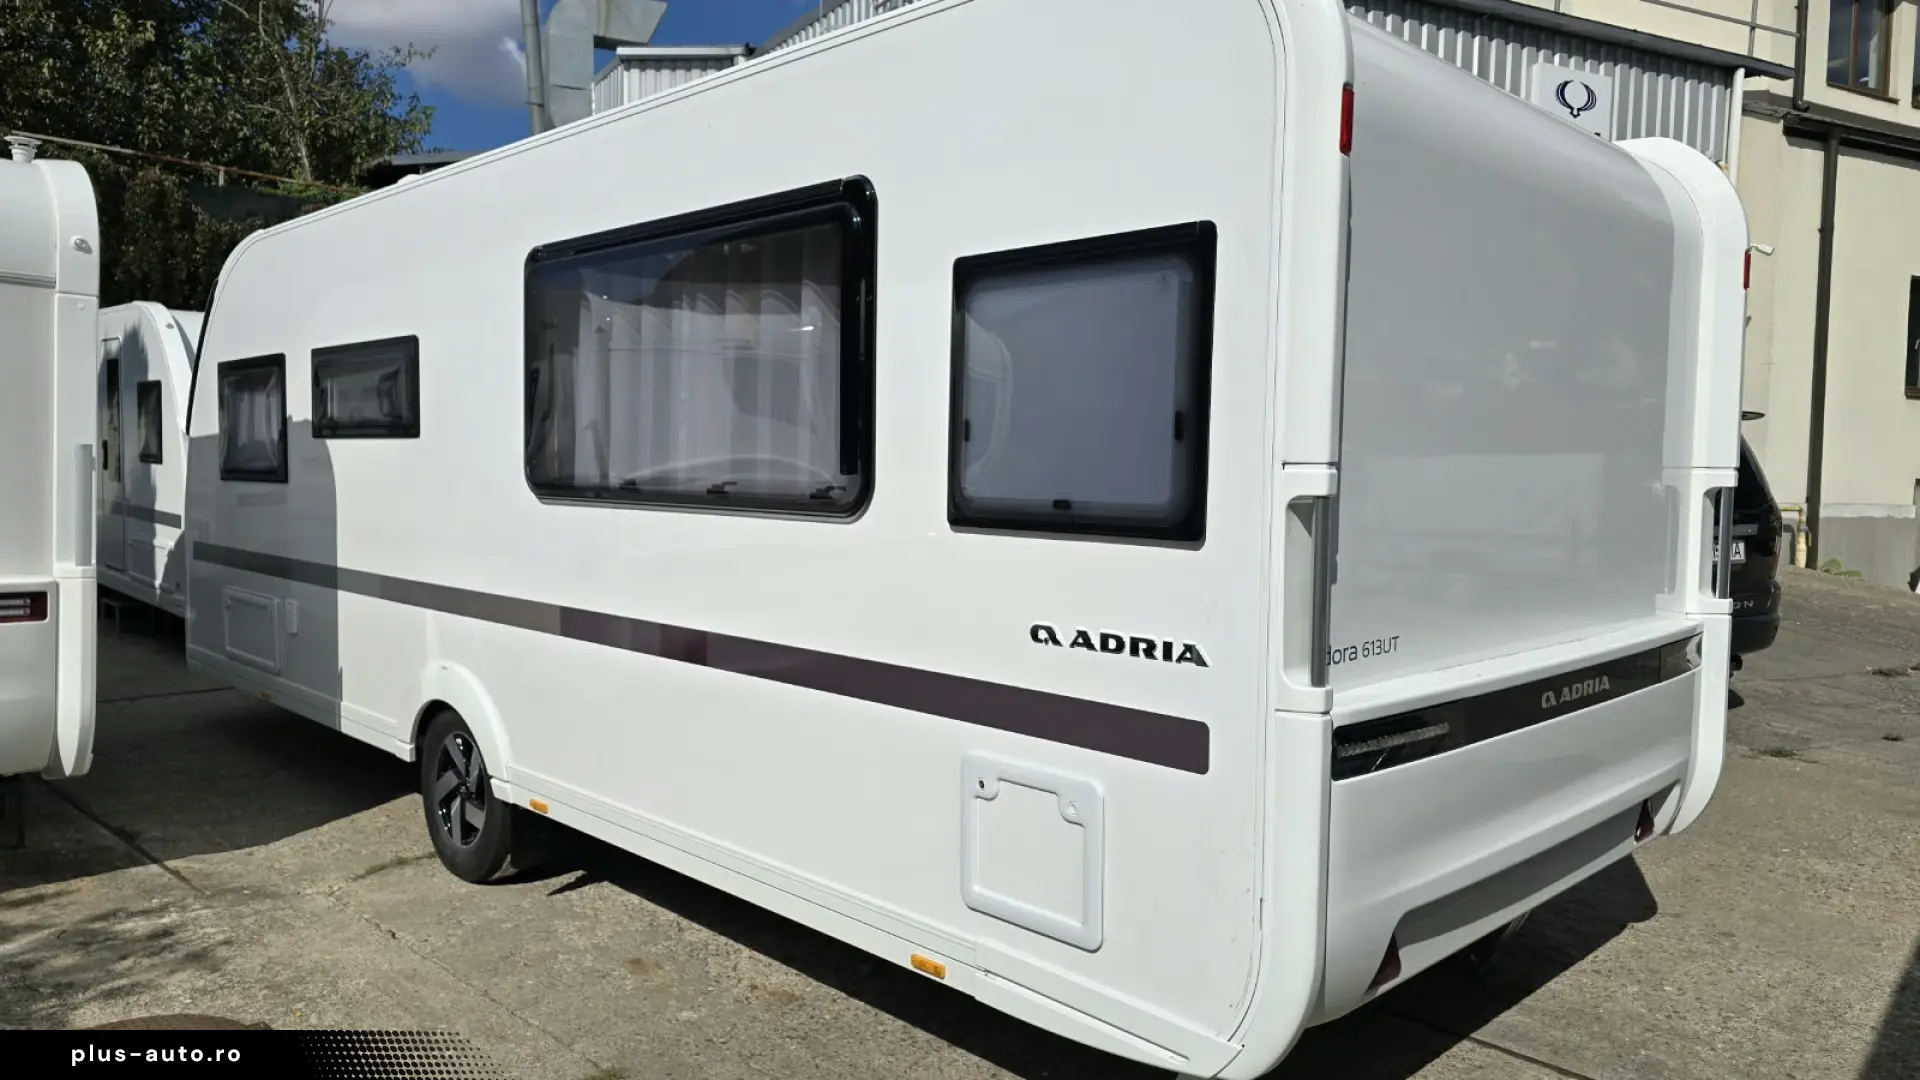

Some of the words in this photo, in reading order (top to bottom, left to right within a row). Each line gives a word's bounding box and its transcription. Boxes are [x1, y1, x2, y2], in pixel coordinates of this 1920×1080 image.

[1069, 629, 1210, 668] ADRIA
[1362, 635, 1400, 658] 613UT
[1560, 675, 1610, 703] ADRIA
